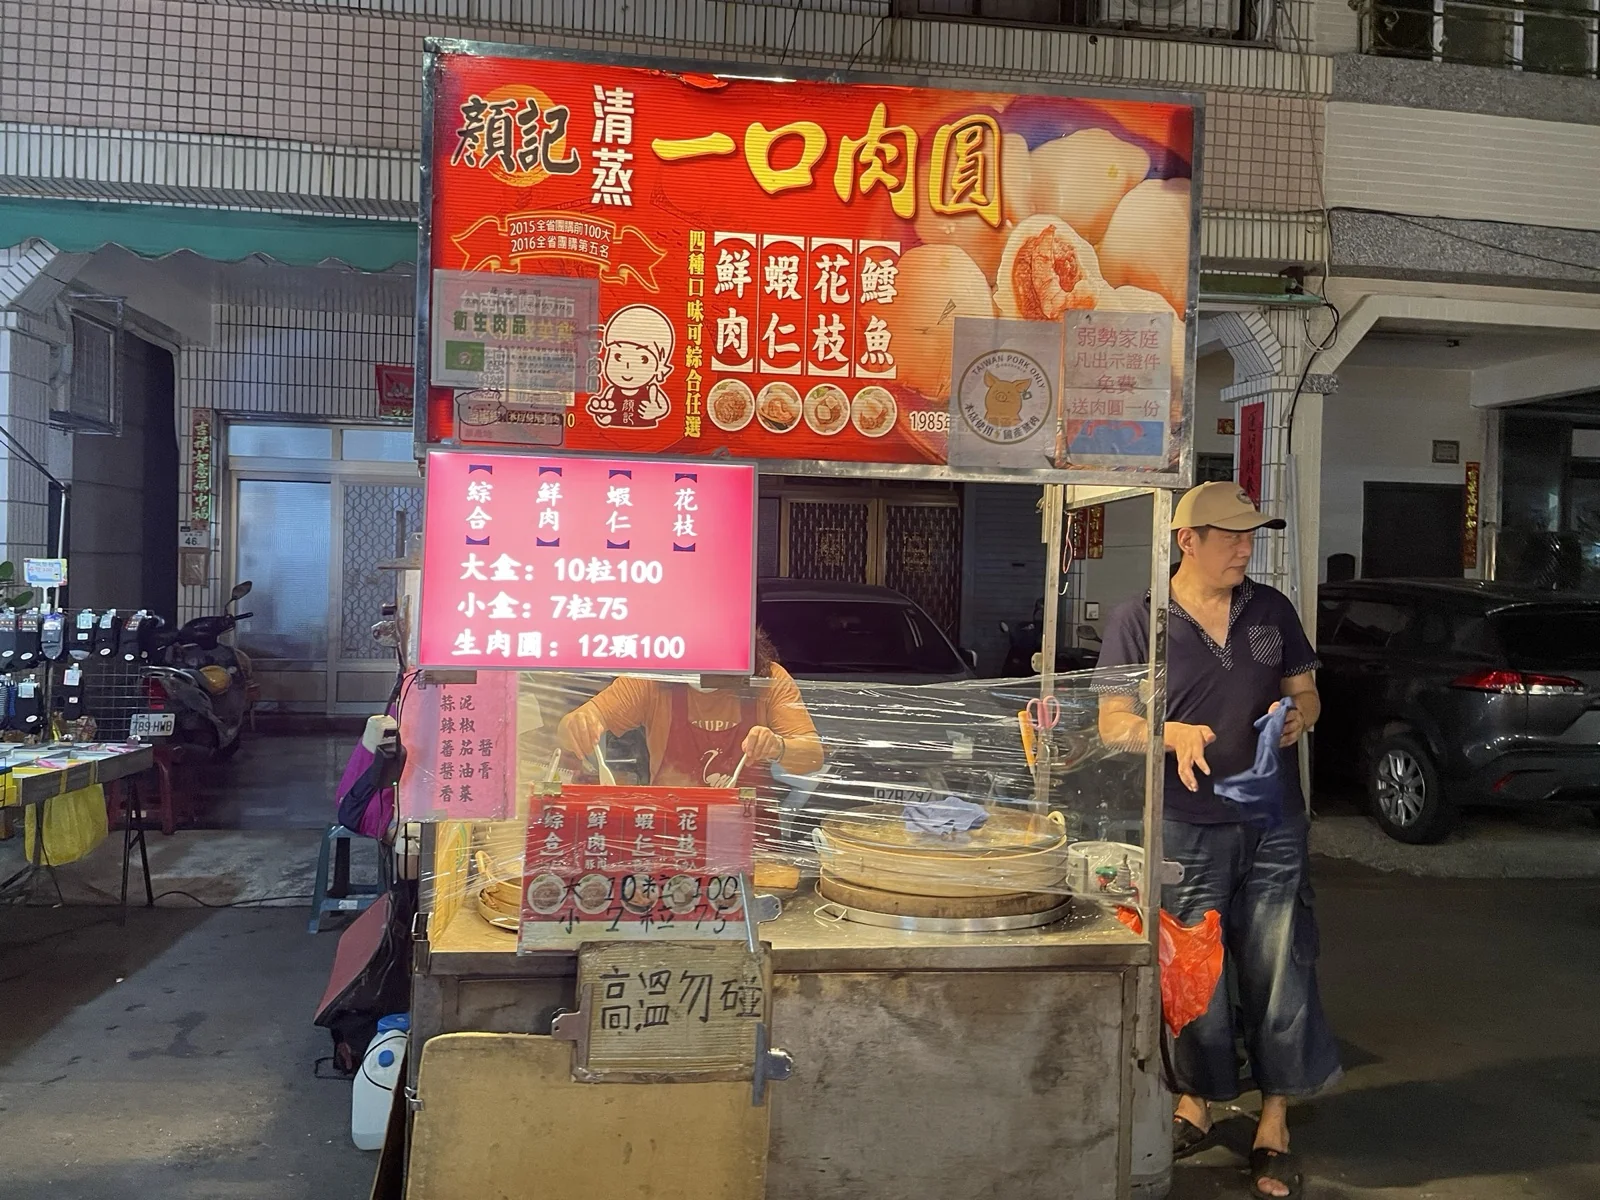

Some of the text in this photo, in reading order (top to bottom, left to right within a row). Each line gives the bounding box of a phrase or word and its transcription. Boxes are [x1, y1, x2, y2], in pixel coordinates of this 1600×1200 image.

[591, 84, 635, 206] 清蒸
[652, 102, 1002, 228] 一口肉圓
[509, 219, 612, 242] 2015全省團購前100大
[511, 235, 610, 258] 2016全省團購第五名
[714, 248, 752, 359] 鮮肉
[762, 255, 802, 359] 蝦仁
[811, 254, 850, 363] 花枝
[860, 257, 898, 365] 鱈魚
[684, 230, 706, 438] 四種口味可綜合任選
[1077, 327, 1160, 349] 弱勢家庭
[972, 355, 1004, 375] TAIWAN
[1006, 354, 1030, 369] PORK
[1030, 368, 1046, 389] ONLY
[1074, 352, 1161, 371] 凡出示證件
[1096, 374, 1137, 395] 免費
[1071, 398, 1161, 417] 送肉圓一份
[465, 481, 494, 530] 綜合
[535, 482, 563, 531] 鮮肉
[605, 486, 633, 533] 蝦仁
[672, 488, 699, 538] 花枝
[440, 694, 475, 712] 蒜泥
[440, 717, 475, 734] 辣椒
[440, 738, 494, 758] 蕃茄醬
[440, 761, 493, 780] 醬油膏
[439, 784, 474, 803] 香菜
[587, 811, 608, 851] 鮮肉
[634, 813, 656, 850] 蝦仁
